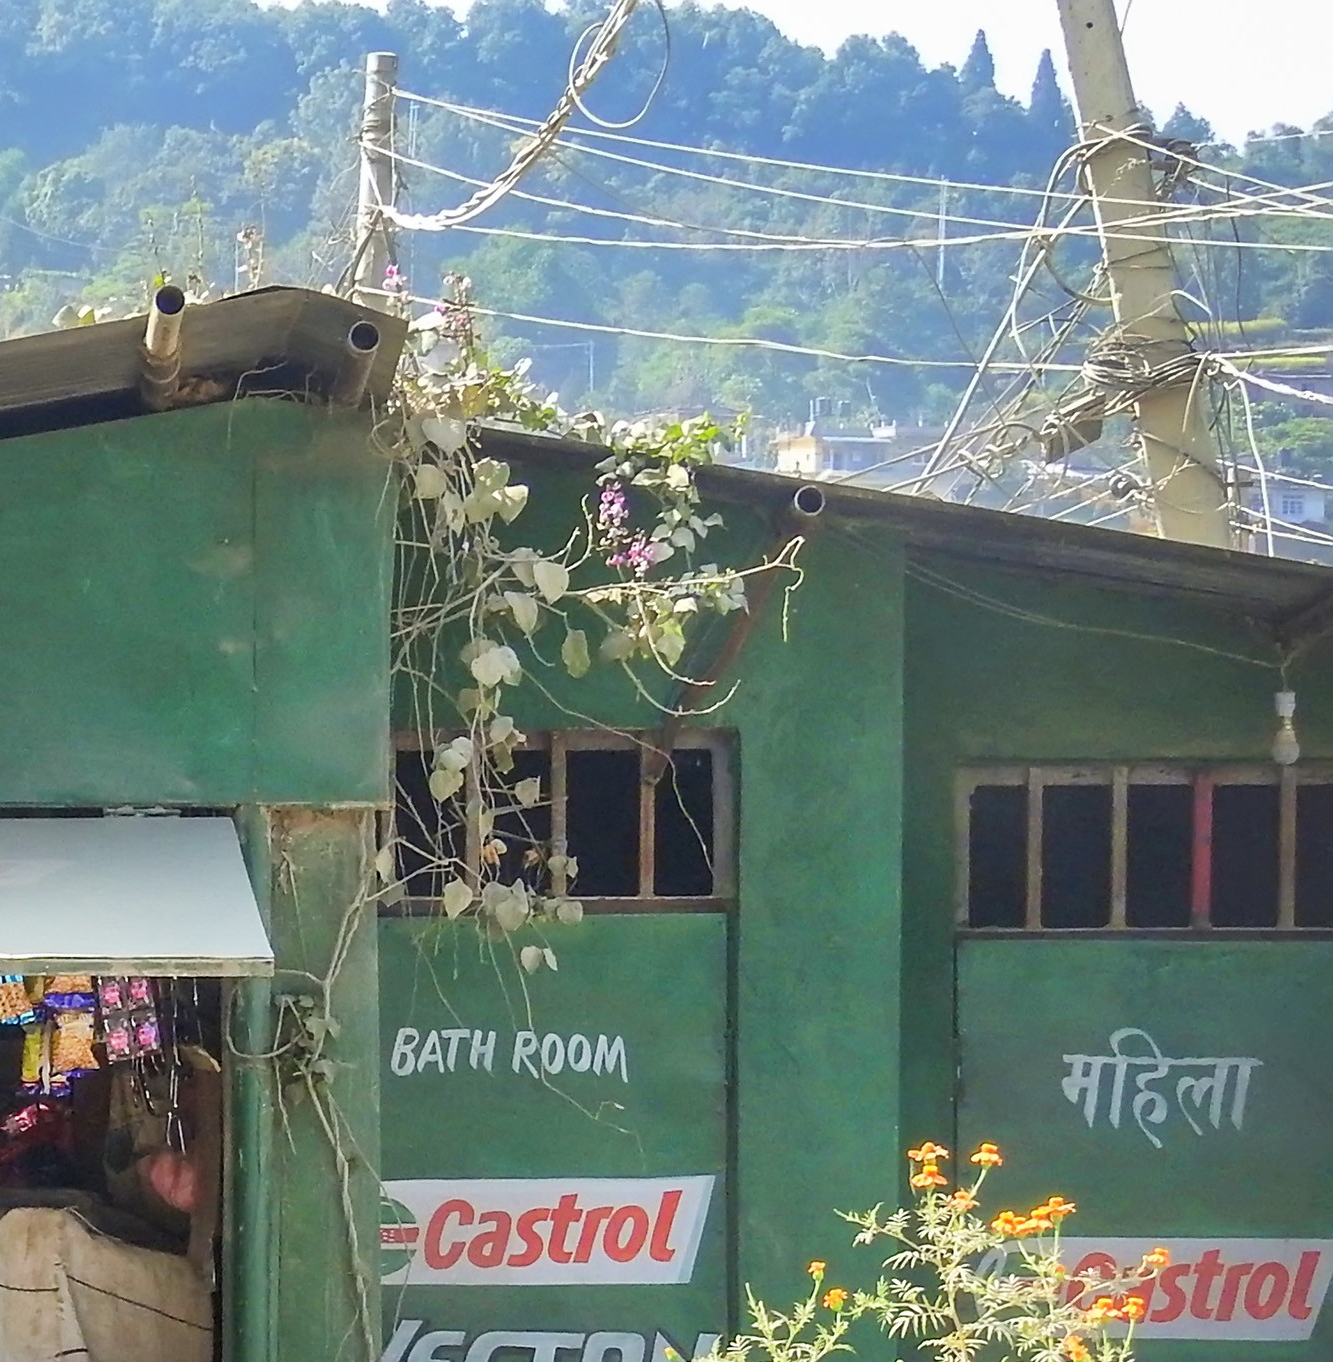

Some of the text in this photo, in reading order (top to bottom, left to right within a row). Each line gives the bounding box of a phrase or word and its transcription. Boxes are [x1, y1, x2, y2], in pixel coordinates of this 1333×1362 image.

[390, 1027, 628, 1083] BATH ROOM
[1062, 1027, 1264, 1149] महिला
[424, 1190, 683, 1270] Castrol
